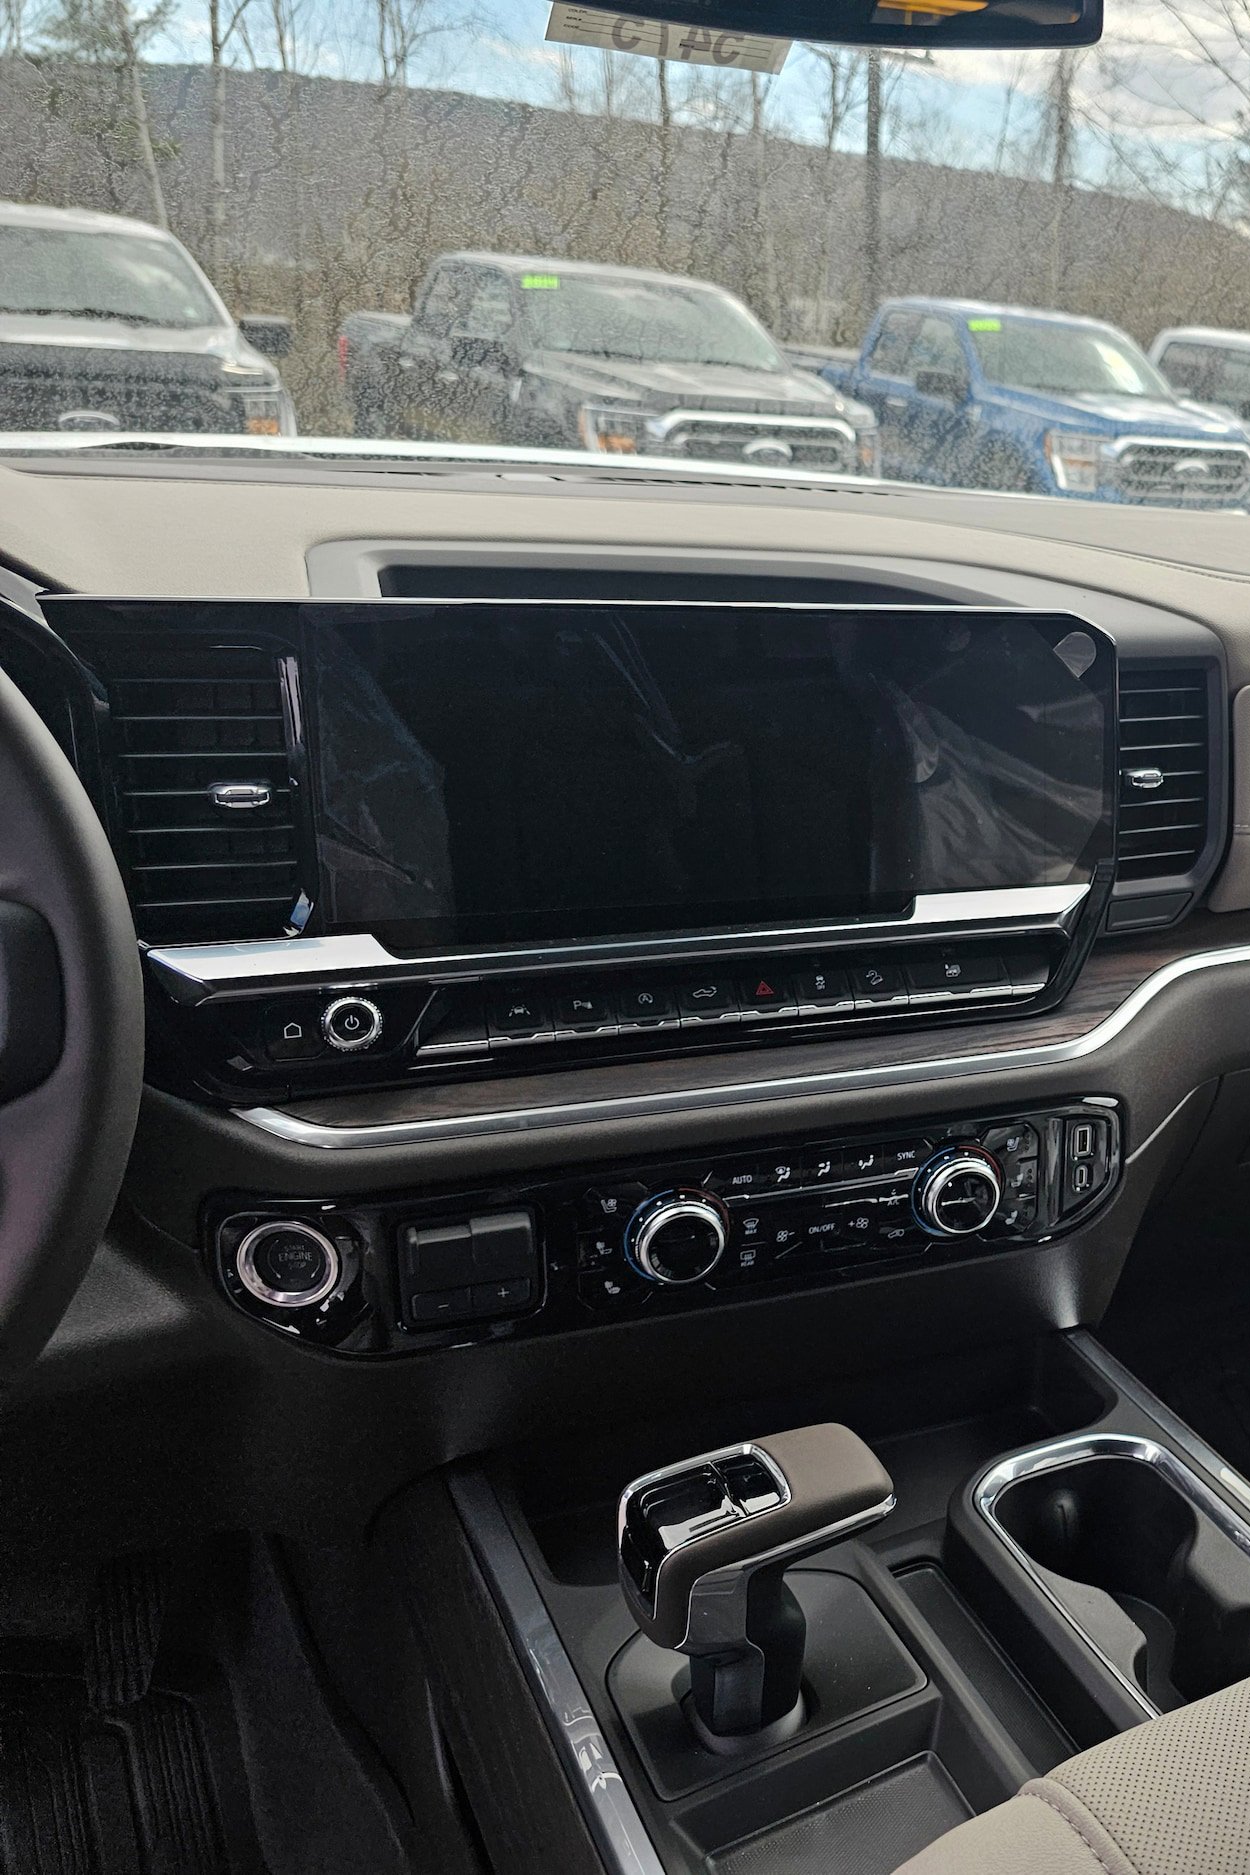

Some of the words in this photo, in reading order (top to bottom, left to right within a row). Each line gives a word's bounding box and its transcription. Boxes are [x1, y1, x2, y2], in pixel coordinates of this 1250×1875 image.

[897, 1151, 916, 1162] SYNC
[732, 1174, 753, 1185] AUTO
[808, 1222, 836, 1236] ON/OFF
[278, 1251, 313, 1263] ENGINE
